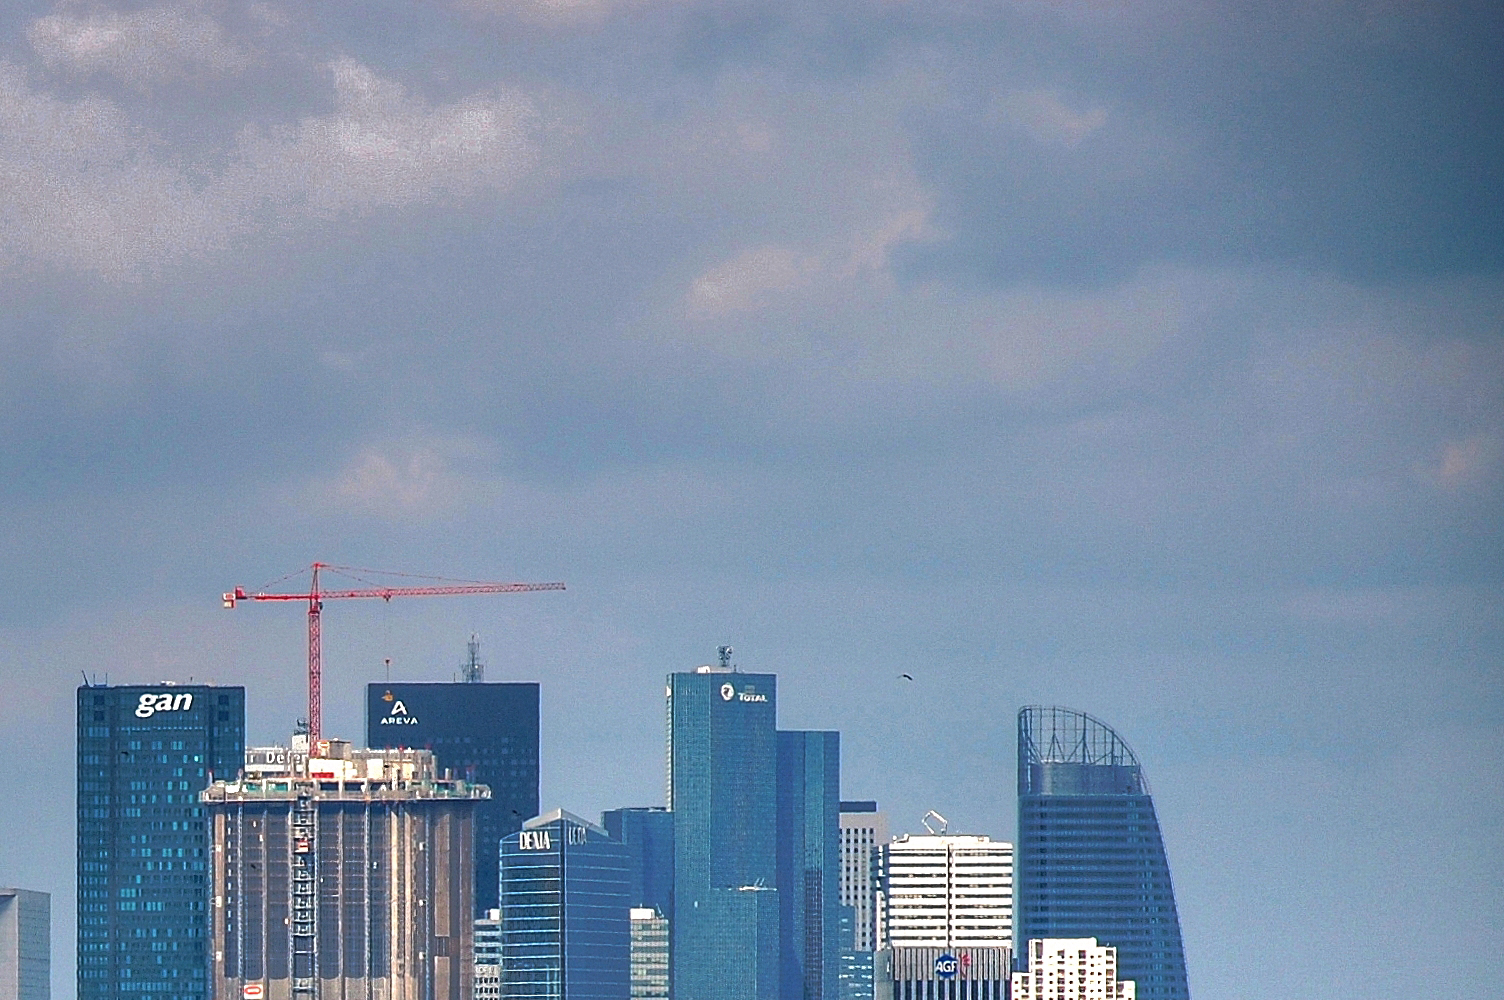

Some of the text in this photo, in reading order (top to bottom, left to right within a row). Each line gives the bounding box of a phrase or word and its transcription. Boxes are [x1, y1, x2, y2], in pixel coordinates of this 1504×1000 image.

[134, 692, 193, 718] gan
[380, 717, 418, 725] AREVA
[936, 961, 958, 973] AGF
